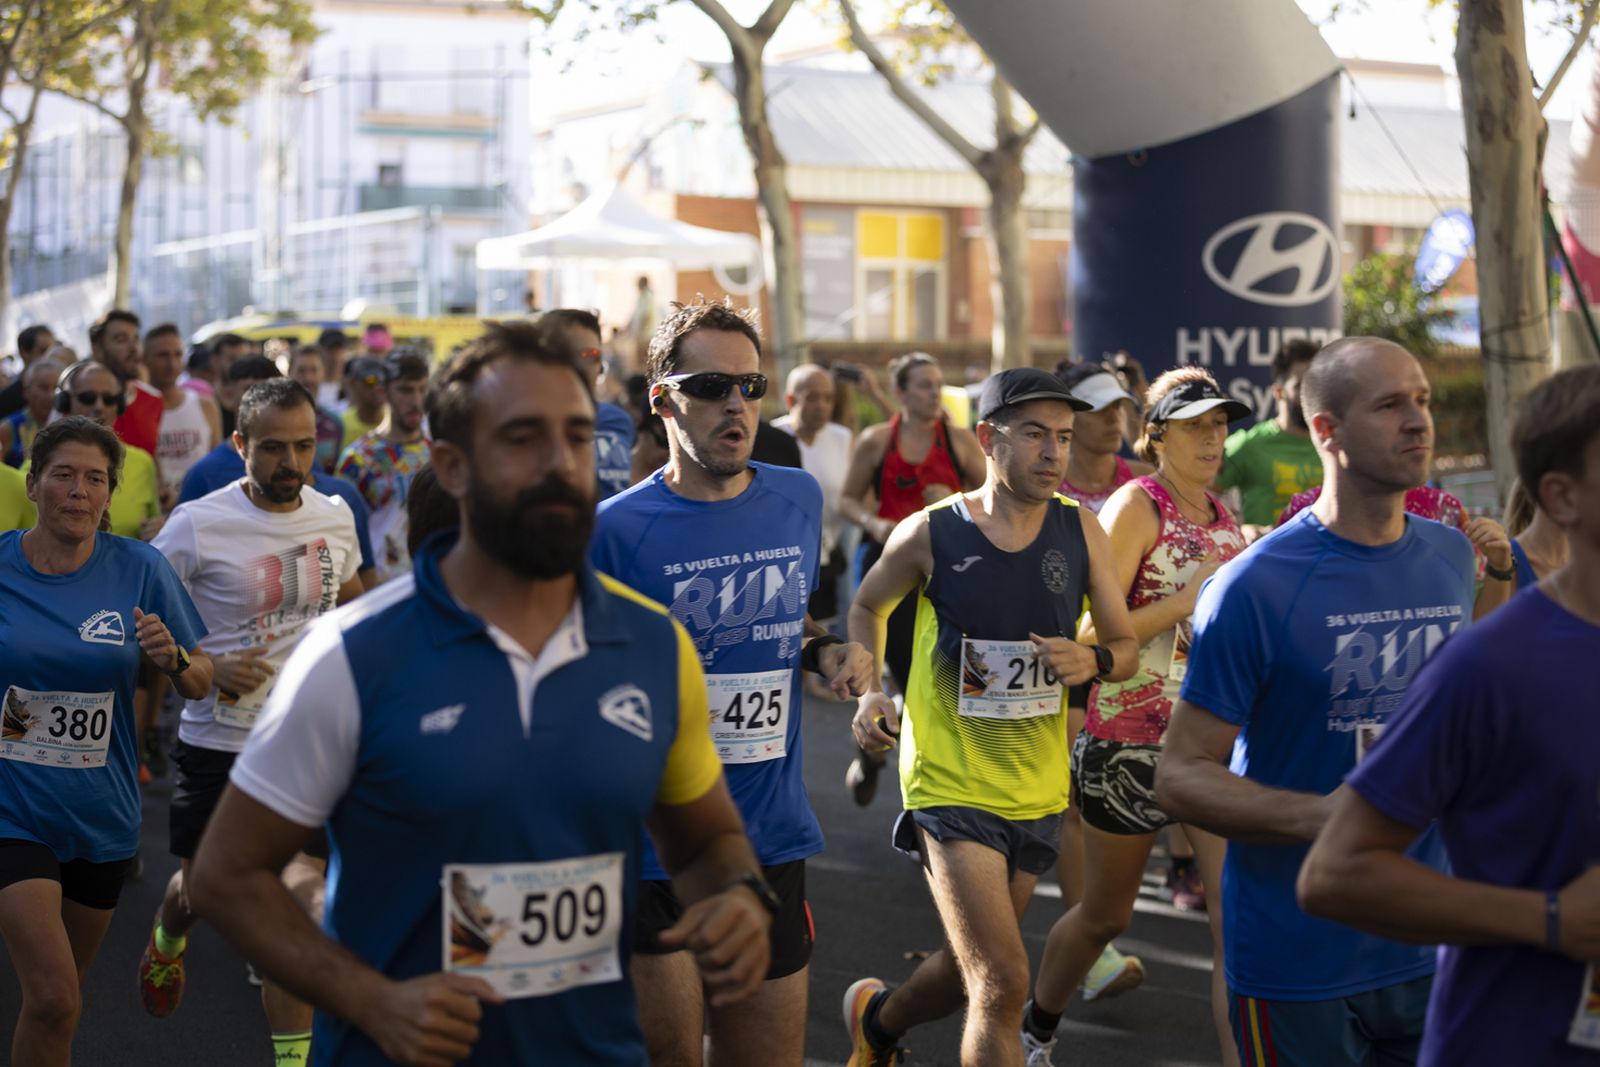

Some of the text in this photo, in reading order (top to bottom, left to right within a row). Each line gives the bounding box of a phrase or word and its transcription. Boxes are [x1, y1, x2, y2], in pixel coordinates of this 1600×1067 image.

[1176, 327, 1343, 366] HYU
[1228, 376, 1275, 422] Sy
[663, 546, 802, 576] 36 VUELTA A HUELVA
[669, 560, 801, 633] RUN
[1324, 604, 1462, 628] 36 VUELTA A HUELVA
[723, 689, 782, 730] 425
[1373, 693, 1405, 714] KEE
[36, 735, 62, 746] BALBINA
[48, 705, 108, 741] 380
[520, 882, 608, 946] 509
